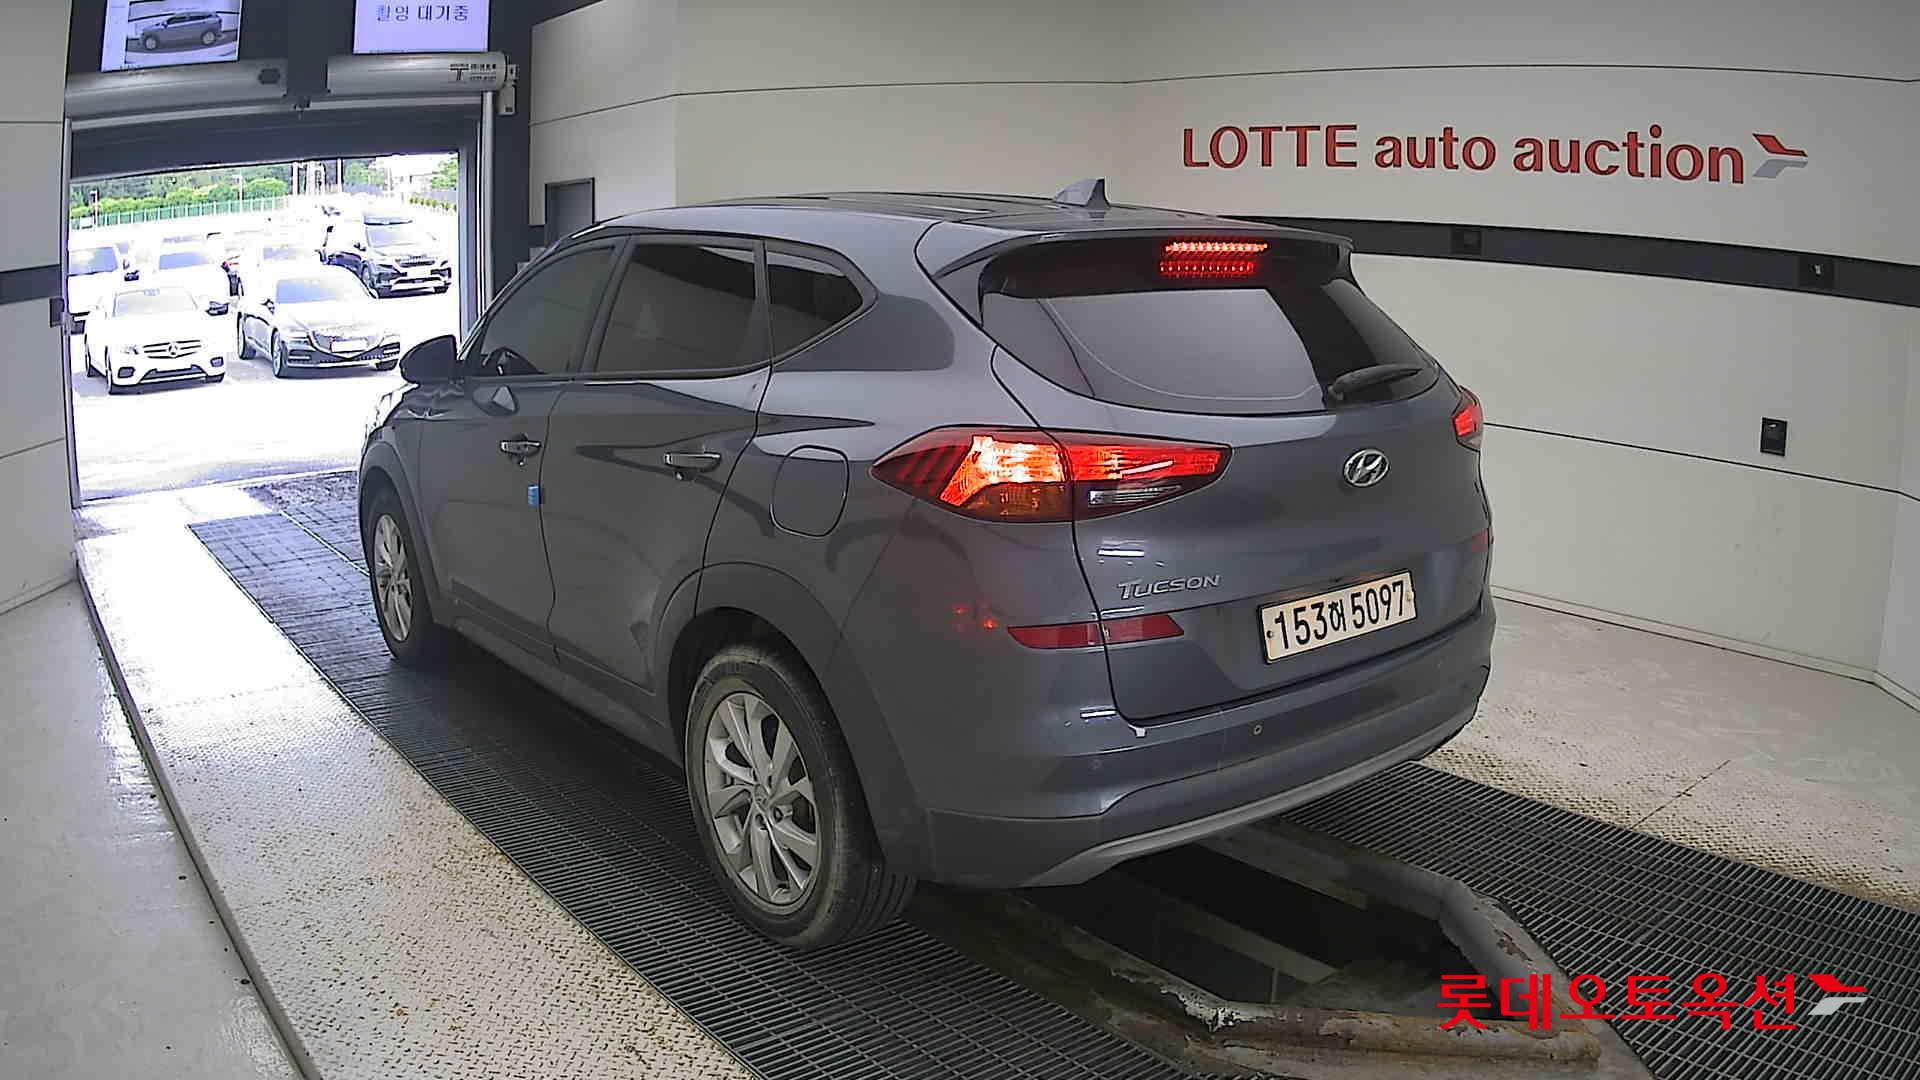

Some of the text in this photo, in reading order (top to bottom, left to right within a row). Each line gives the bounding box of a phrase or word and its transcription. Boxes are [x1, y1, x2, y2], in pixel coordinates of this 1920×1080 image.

[417, 4, 469, 21] 대기중
[1182, 123, 1745, 184] LOTTE auto auction
